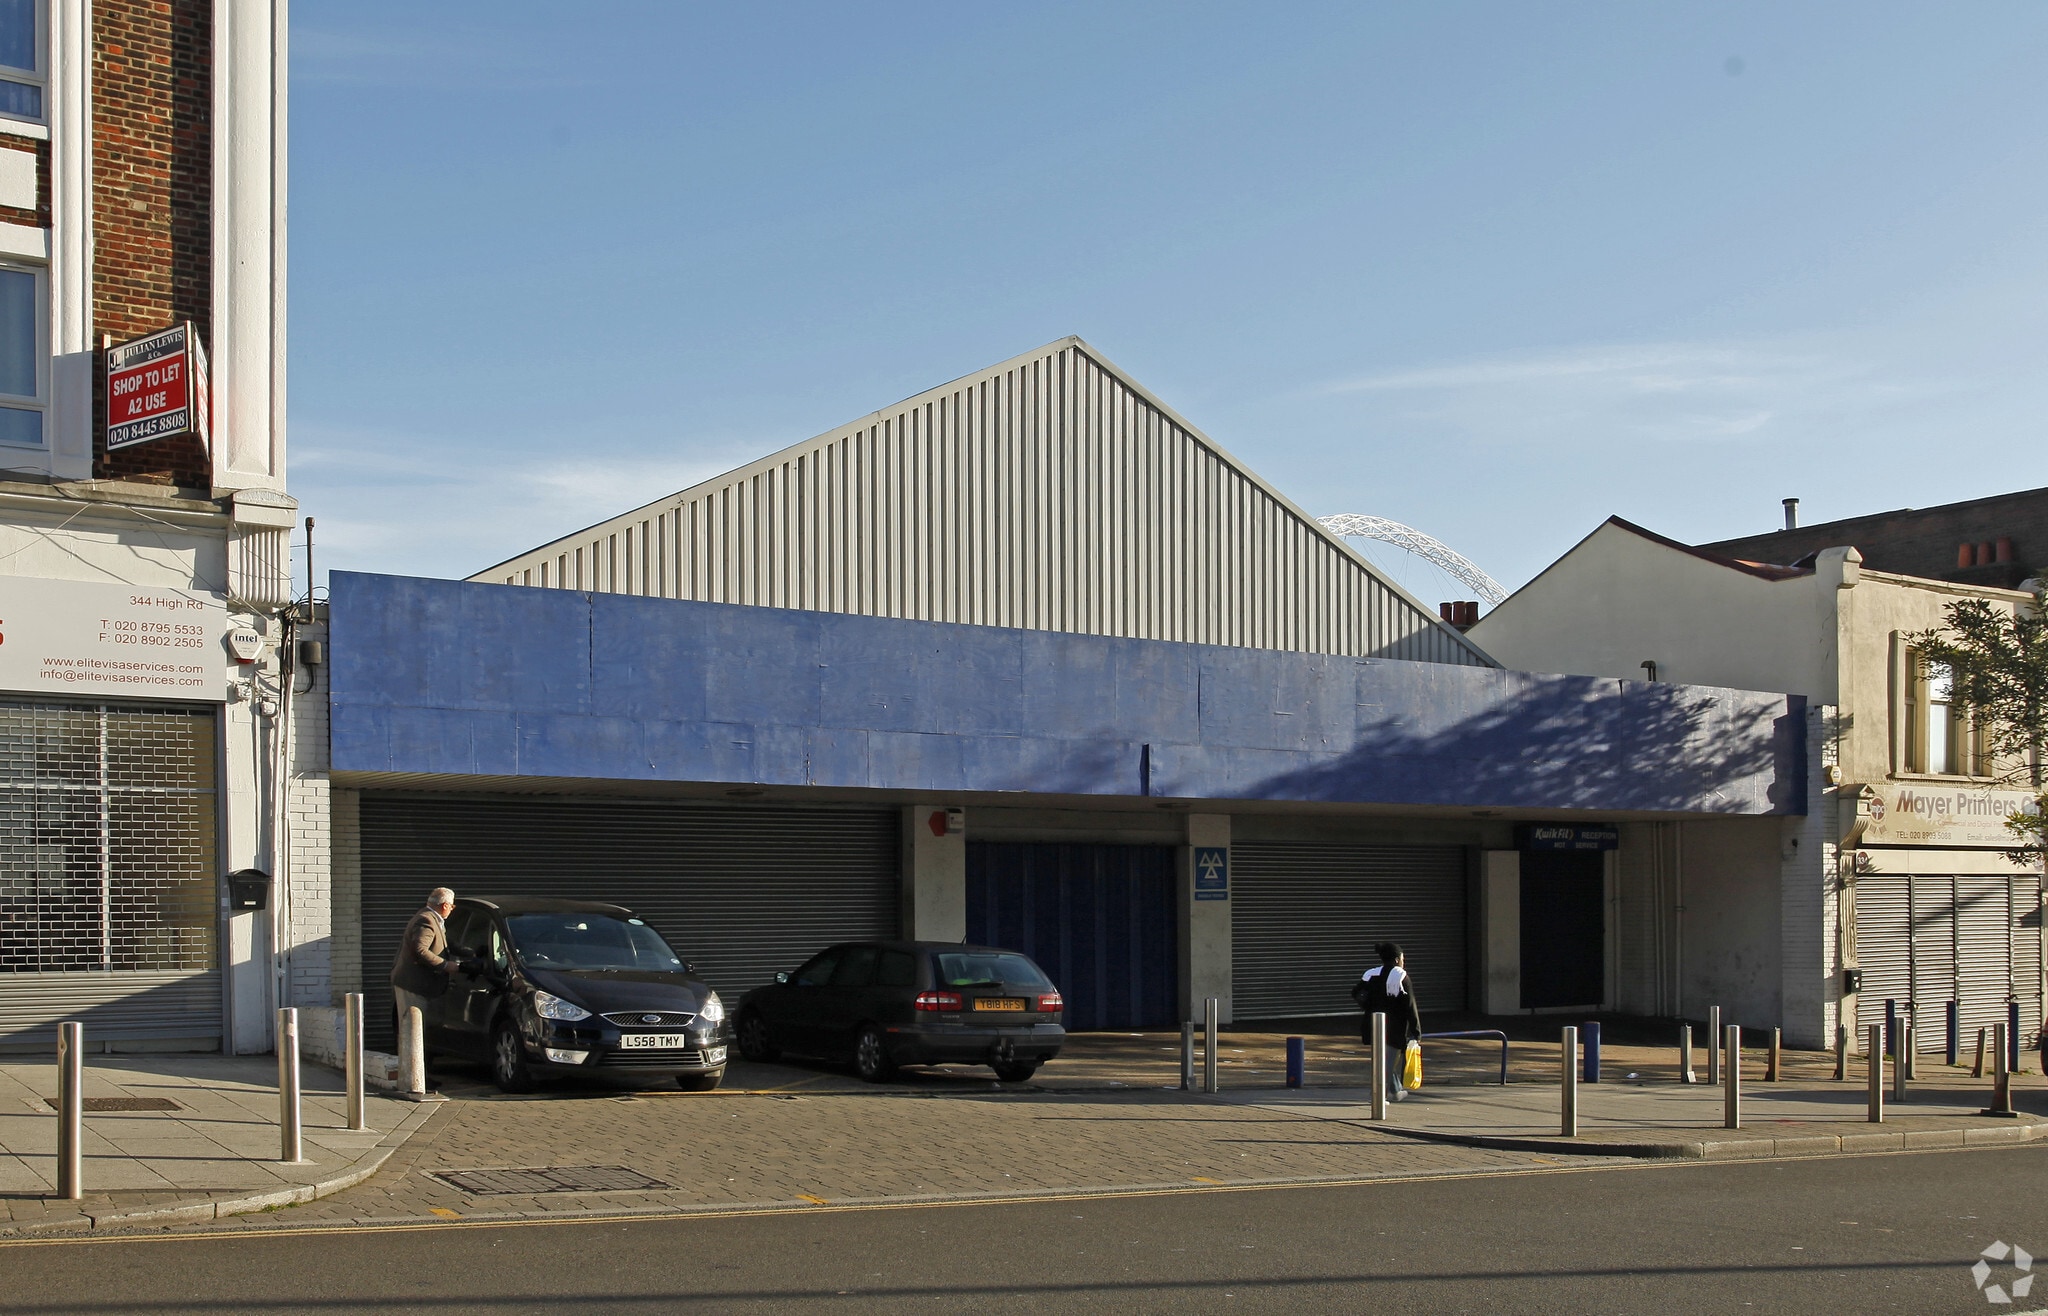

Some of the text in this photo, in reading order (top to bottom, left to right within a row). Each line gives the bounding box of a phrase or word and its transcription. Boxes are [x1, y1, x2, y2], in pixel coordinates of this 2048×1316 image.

[125, 331, 183, 359] JULIAN LEWIS
[113, 362, 180, 397] SHOP TO LET
[127, 391, 167, 416] A2 USE
[110, 412, 185, 444] 020 8445 8808
[129, 595, 203, 611] 344 High Rd
[101, 619, 204, 636] T: 020 8795 5533
[99, 632, 204, 649] F: 020 8902 2505
[235, 633, 258, 643] intel
[43, 656, 203, 674] www.elitevisaservices.com
[40, 668, 203, 687] info@elitevisaservices.com
[1896, 790, 1952, 818] Mayer
[1956, 793, 2017, 816] Printers
[1581, 832, 1617, 840] RECEPTION
[1896, 831, 1909, 839] TEL:
[1909, 831, 1921, 840] 020
[1003, 999, 1021, 1009] HFS
[626, 1036, 680, 1047] LS58 TMY
